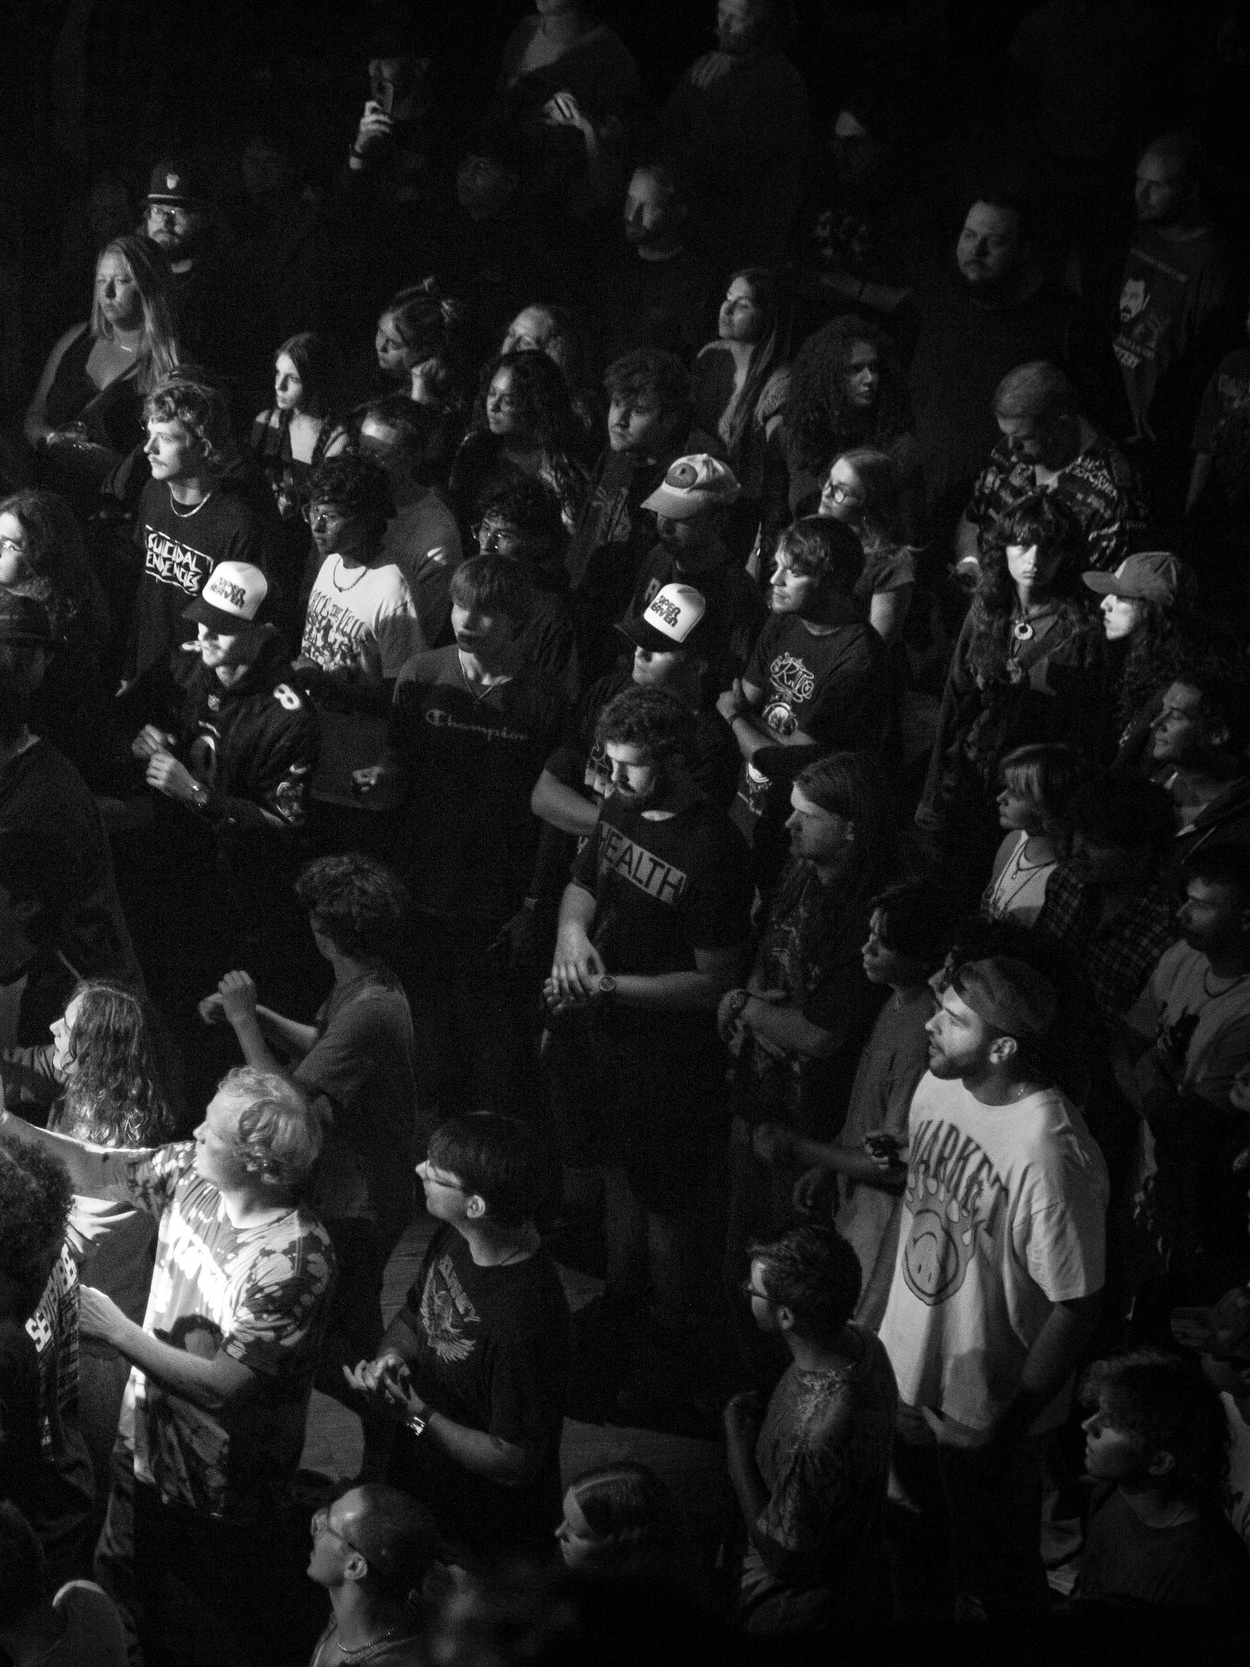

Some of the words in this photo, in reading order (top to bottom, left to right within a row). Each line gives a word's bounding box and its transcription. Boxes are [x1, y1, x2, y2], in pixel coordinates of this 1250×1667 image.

[147, 532, 203, 574] SUICIDAL
[650, 600, 679, 628] EAVEN
[657, 594, 682, 618] UPER
[272, 682, 302, 711] 8
[425, 708, 530, 742] Champion
[599, 824, 687, 899] HEALTH
[908, 1117, 1010, 1239] MARKET
